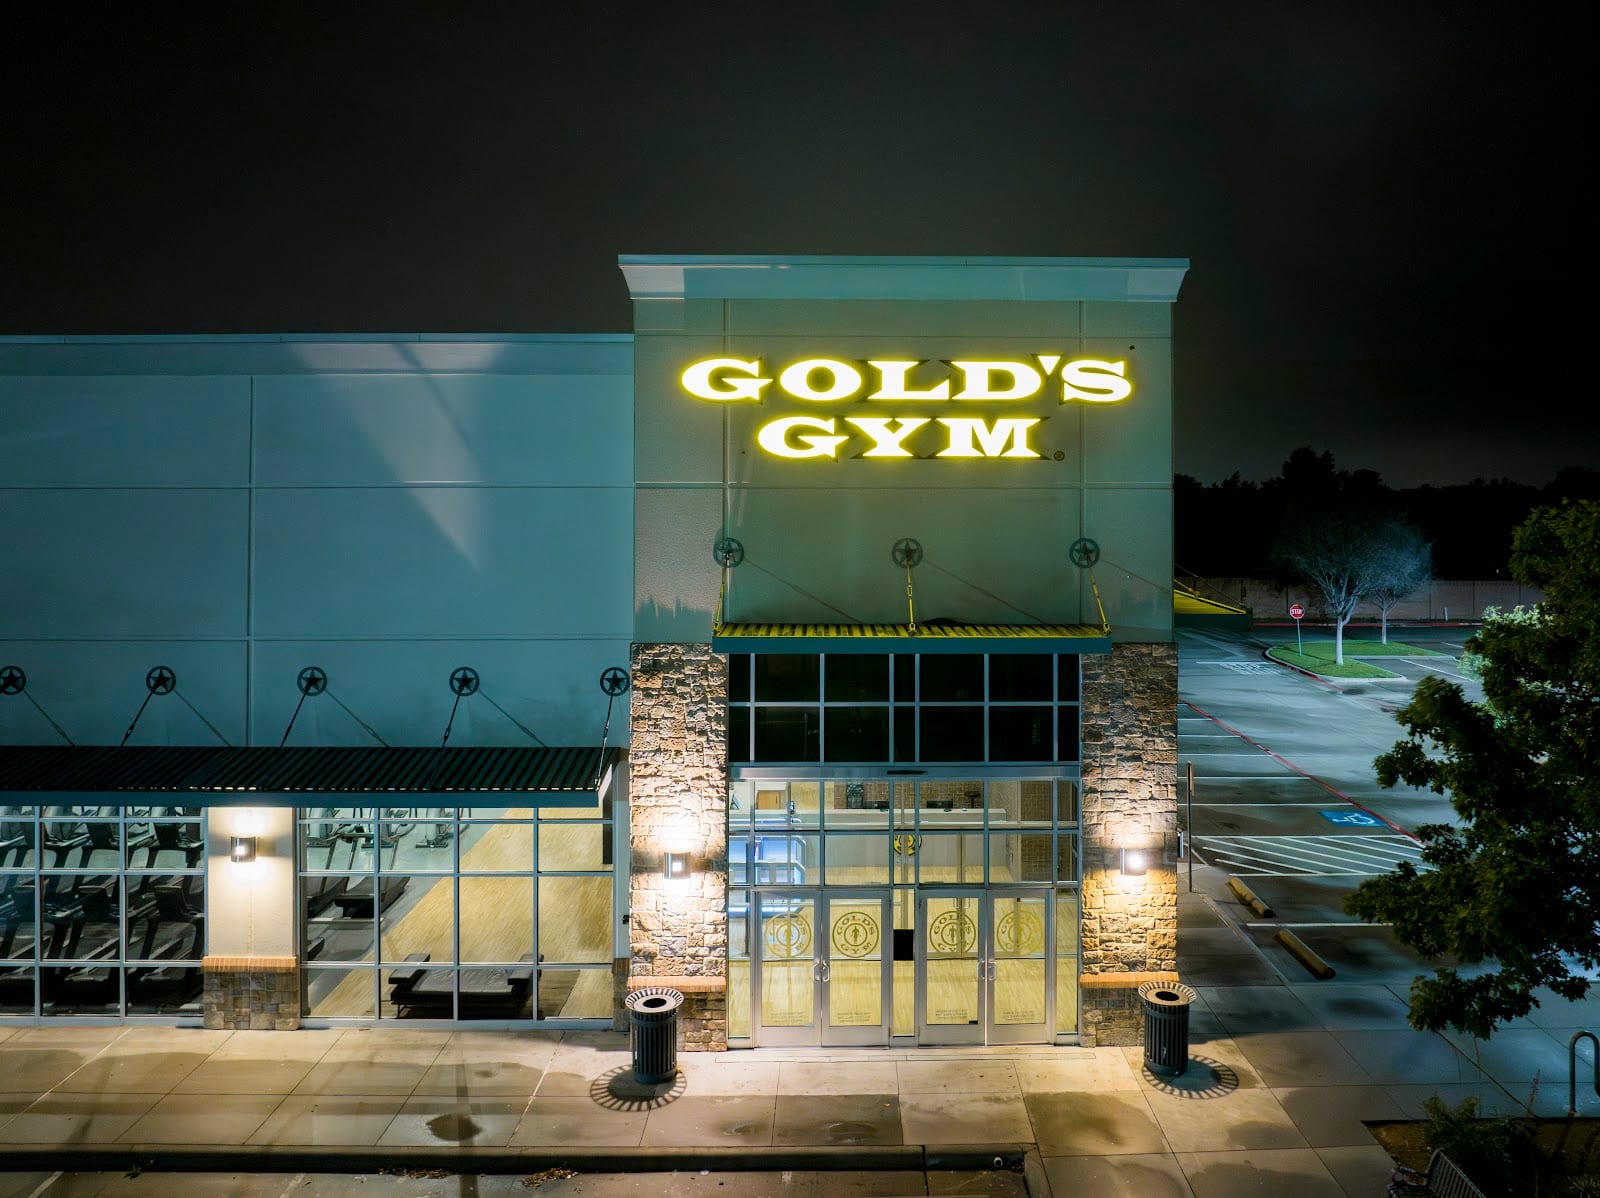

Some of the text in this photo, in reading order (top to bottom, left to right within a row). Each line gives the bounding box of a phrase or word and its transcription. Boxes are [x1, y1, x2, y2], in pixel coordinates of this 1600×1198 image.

[680, 355, 1133, 402] GOLD'S
[757, 416, 1044, 459] GYM
[836, 915, 875, 936] GOLD'S
[840, 941, 873, 954] GYM
